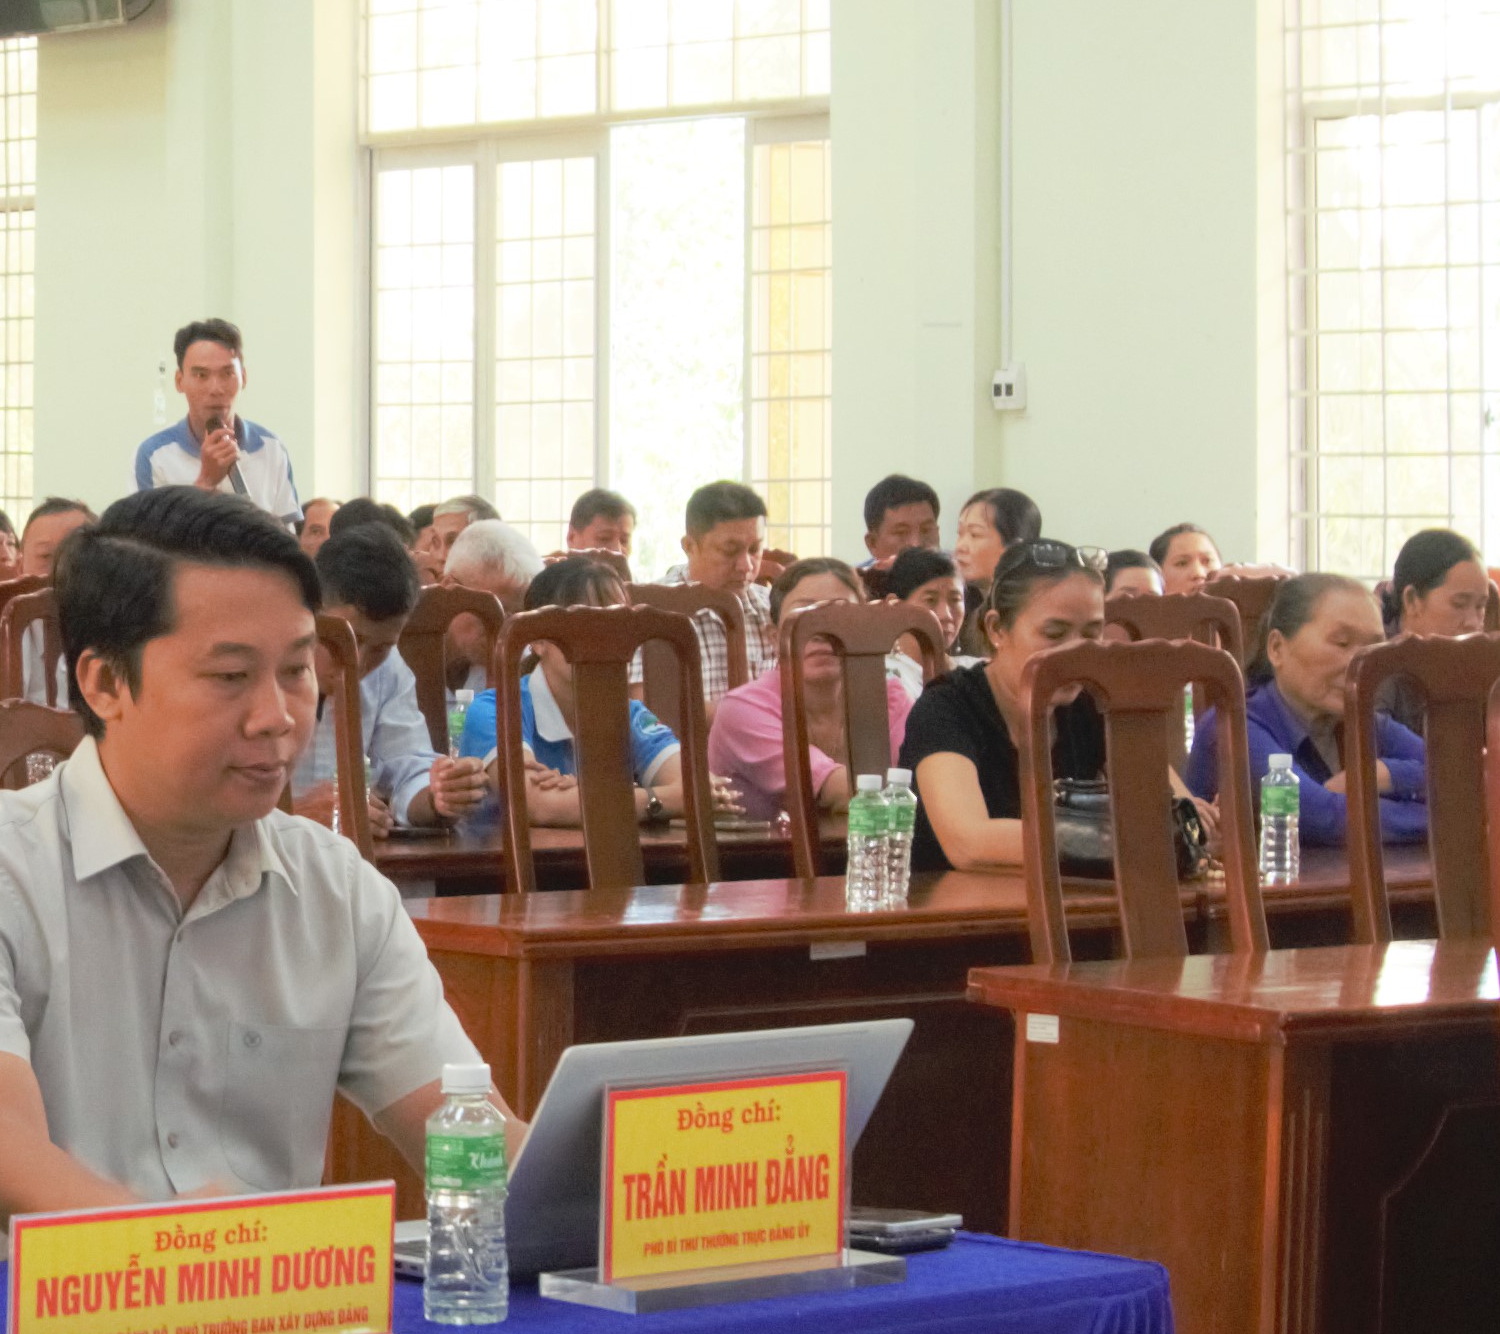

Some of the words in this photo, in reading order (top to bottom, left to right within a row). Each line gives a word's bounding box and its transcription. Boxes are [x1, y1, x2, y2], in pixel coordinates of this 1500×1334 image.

[677, 1101, 734, 1134] Đồng
[740, 1098, 782, 1125] chí:
[622, 1152, 687, 1221] TRẦN
[694, 1161, 759, 1213] MINH
[765, 1133, 831, 1207] ĐẲNG
[155, 1226, 217, 1255] Đồng
[224, 1221, 269, 1246] chí:
[36, 1252, 168, 1318] NGUYỄN
[177, 1250, 261, 1304] MINH
[271, 1244, 375, 1294] DƯƠNG
